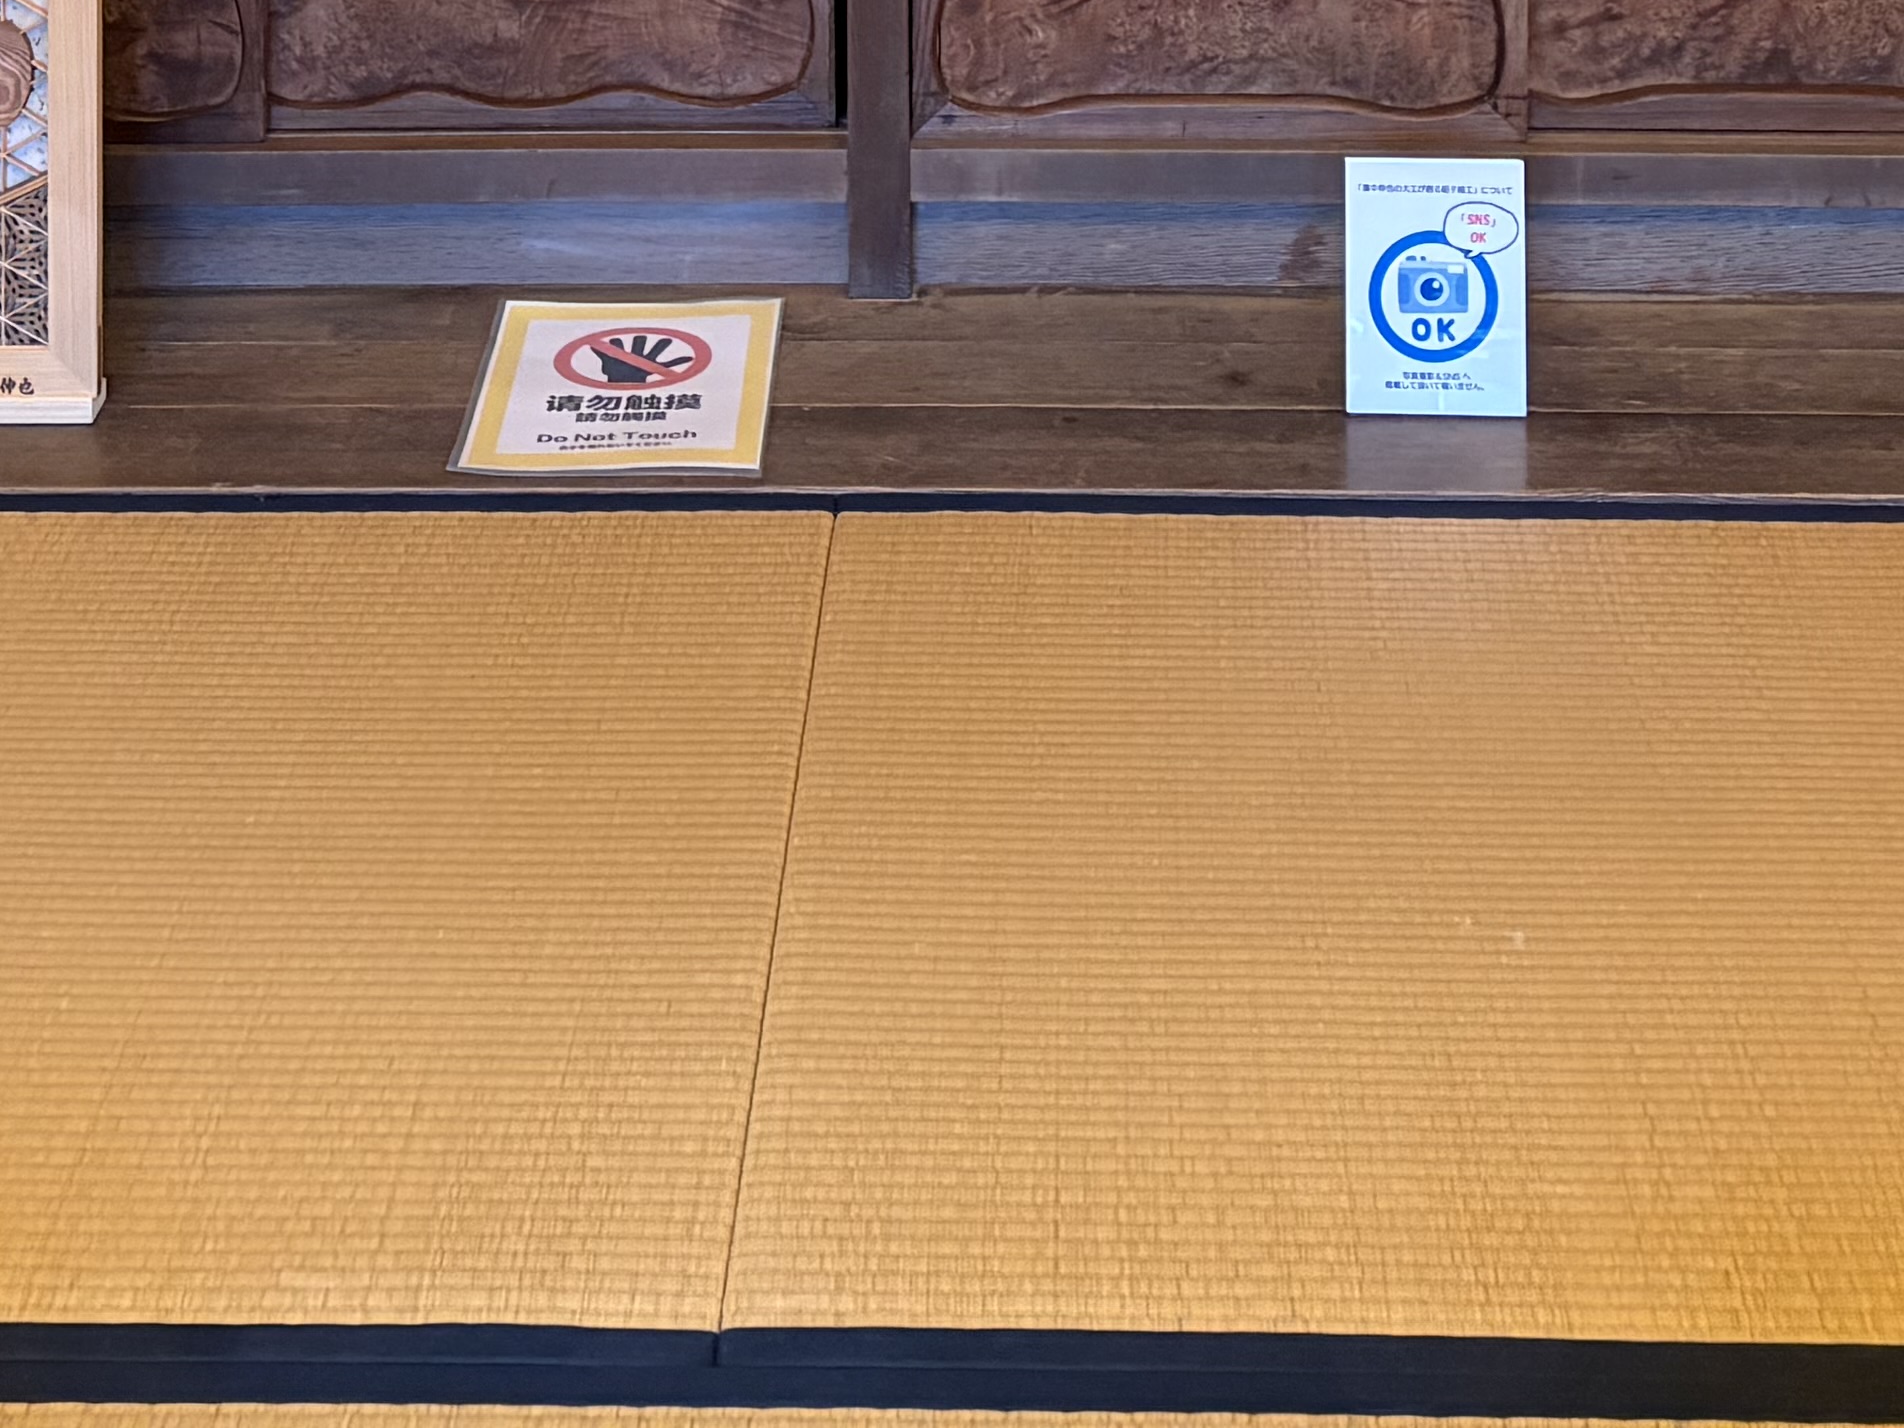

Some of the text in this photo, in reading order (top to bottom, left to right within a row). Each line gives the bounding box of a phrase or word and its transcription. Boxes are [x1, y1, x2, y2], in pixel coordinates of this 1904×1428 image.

[1470, 231, 1487, 244] OK
[1411, 317, 1456, 343] OK
[546, 394, 702, 411] 请勿触摸
[536, 429, 698, 444] Do Not Touch
